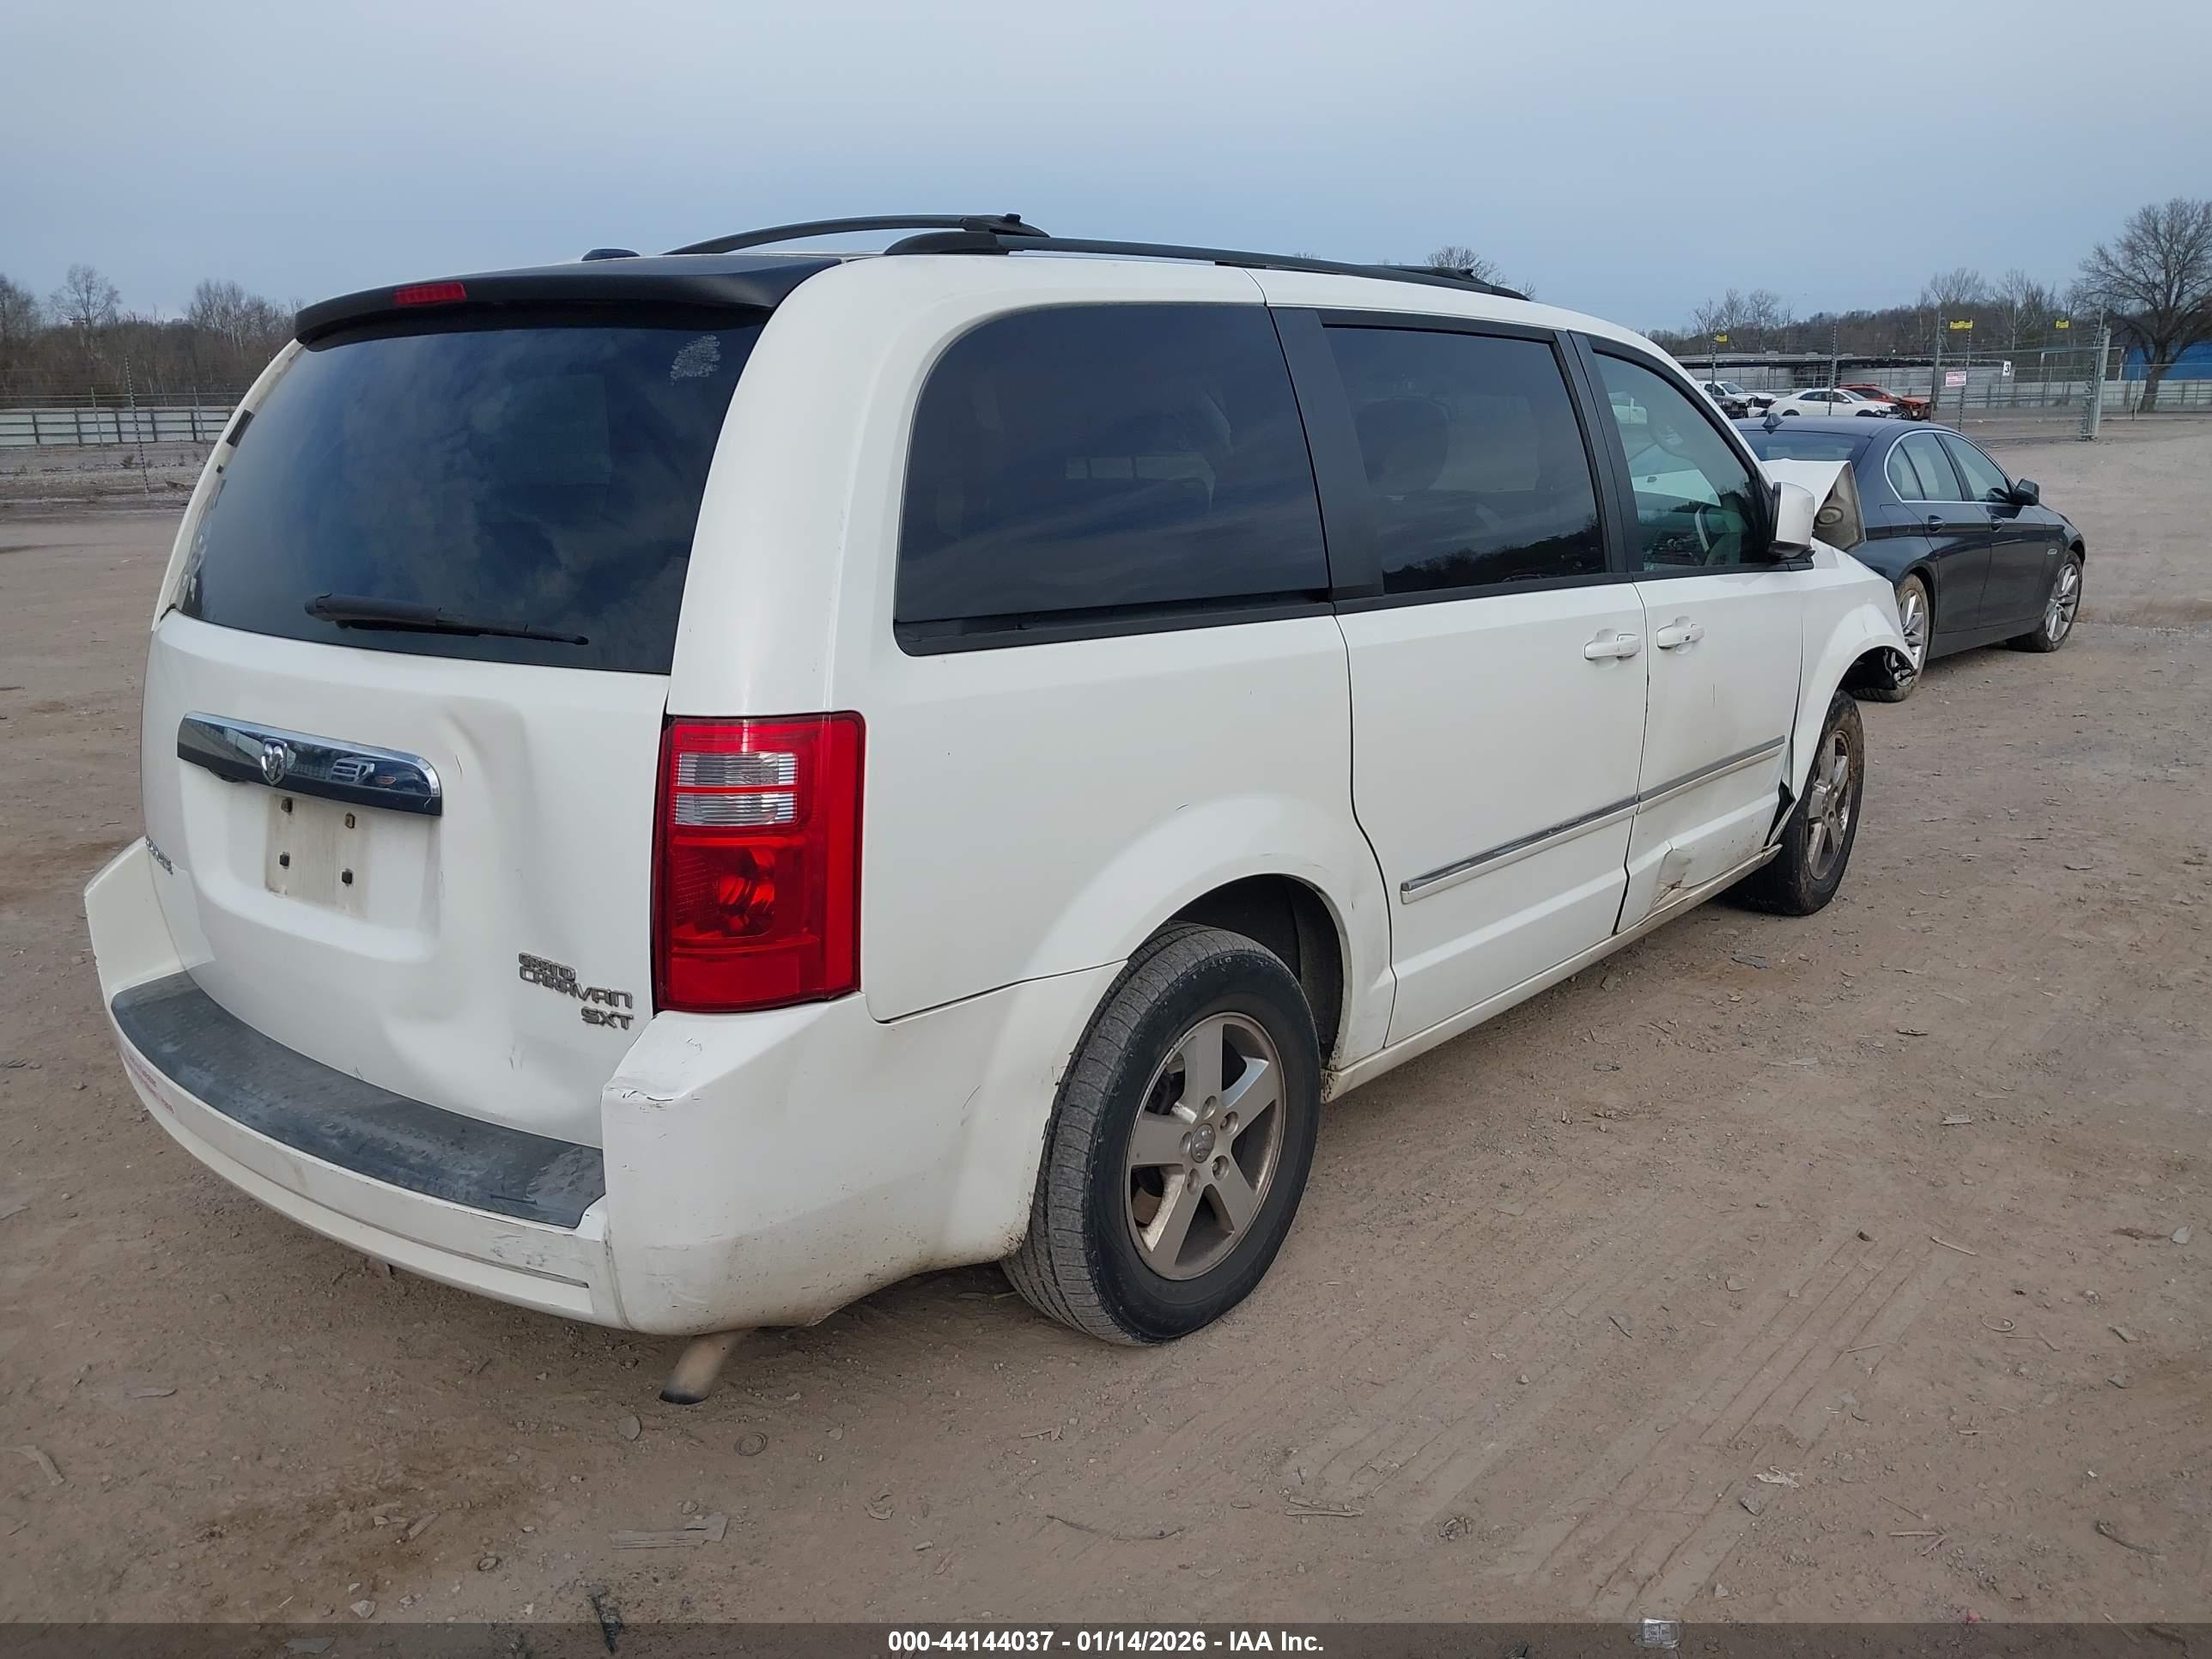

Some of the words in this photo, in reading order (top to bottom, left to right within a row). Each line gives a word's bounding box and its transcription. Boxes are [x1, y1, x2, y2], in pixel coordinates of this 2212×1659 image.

[2004, 364, 2010, 374] 3
[519, 952, 576, 982] GRAND
[520, 964, 633, 1009] CARAVAN
[580, 1006, 634, 1030] SXT
